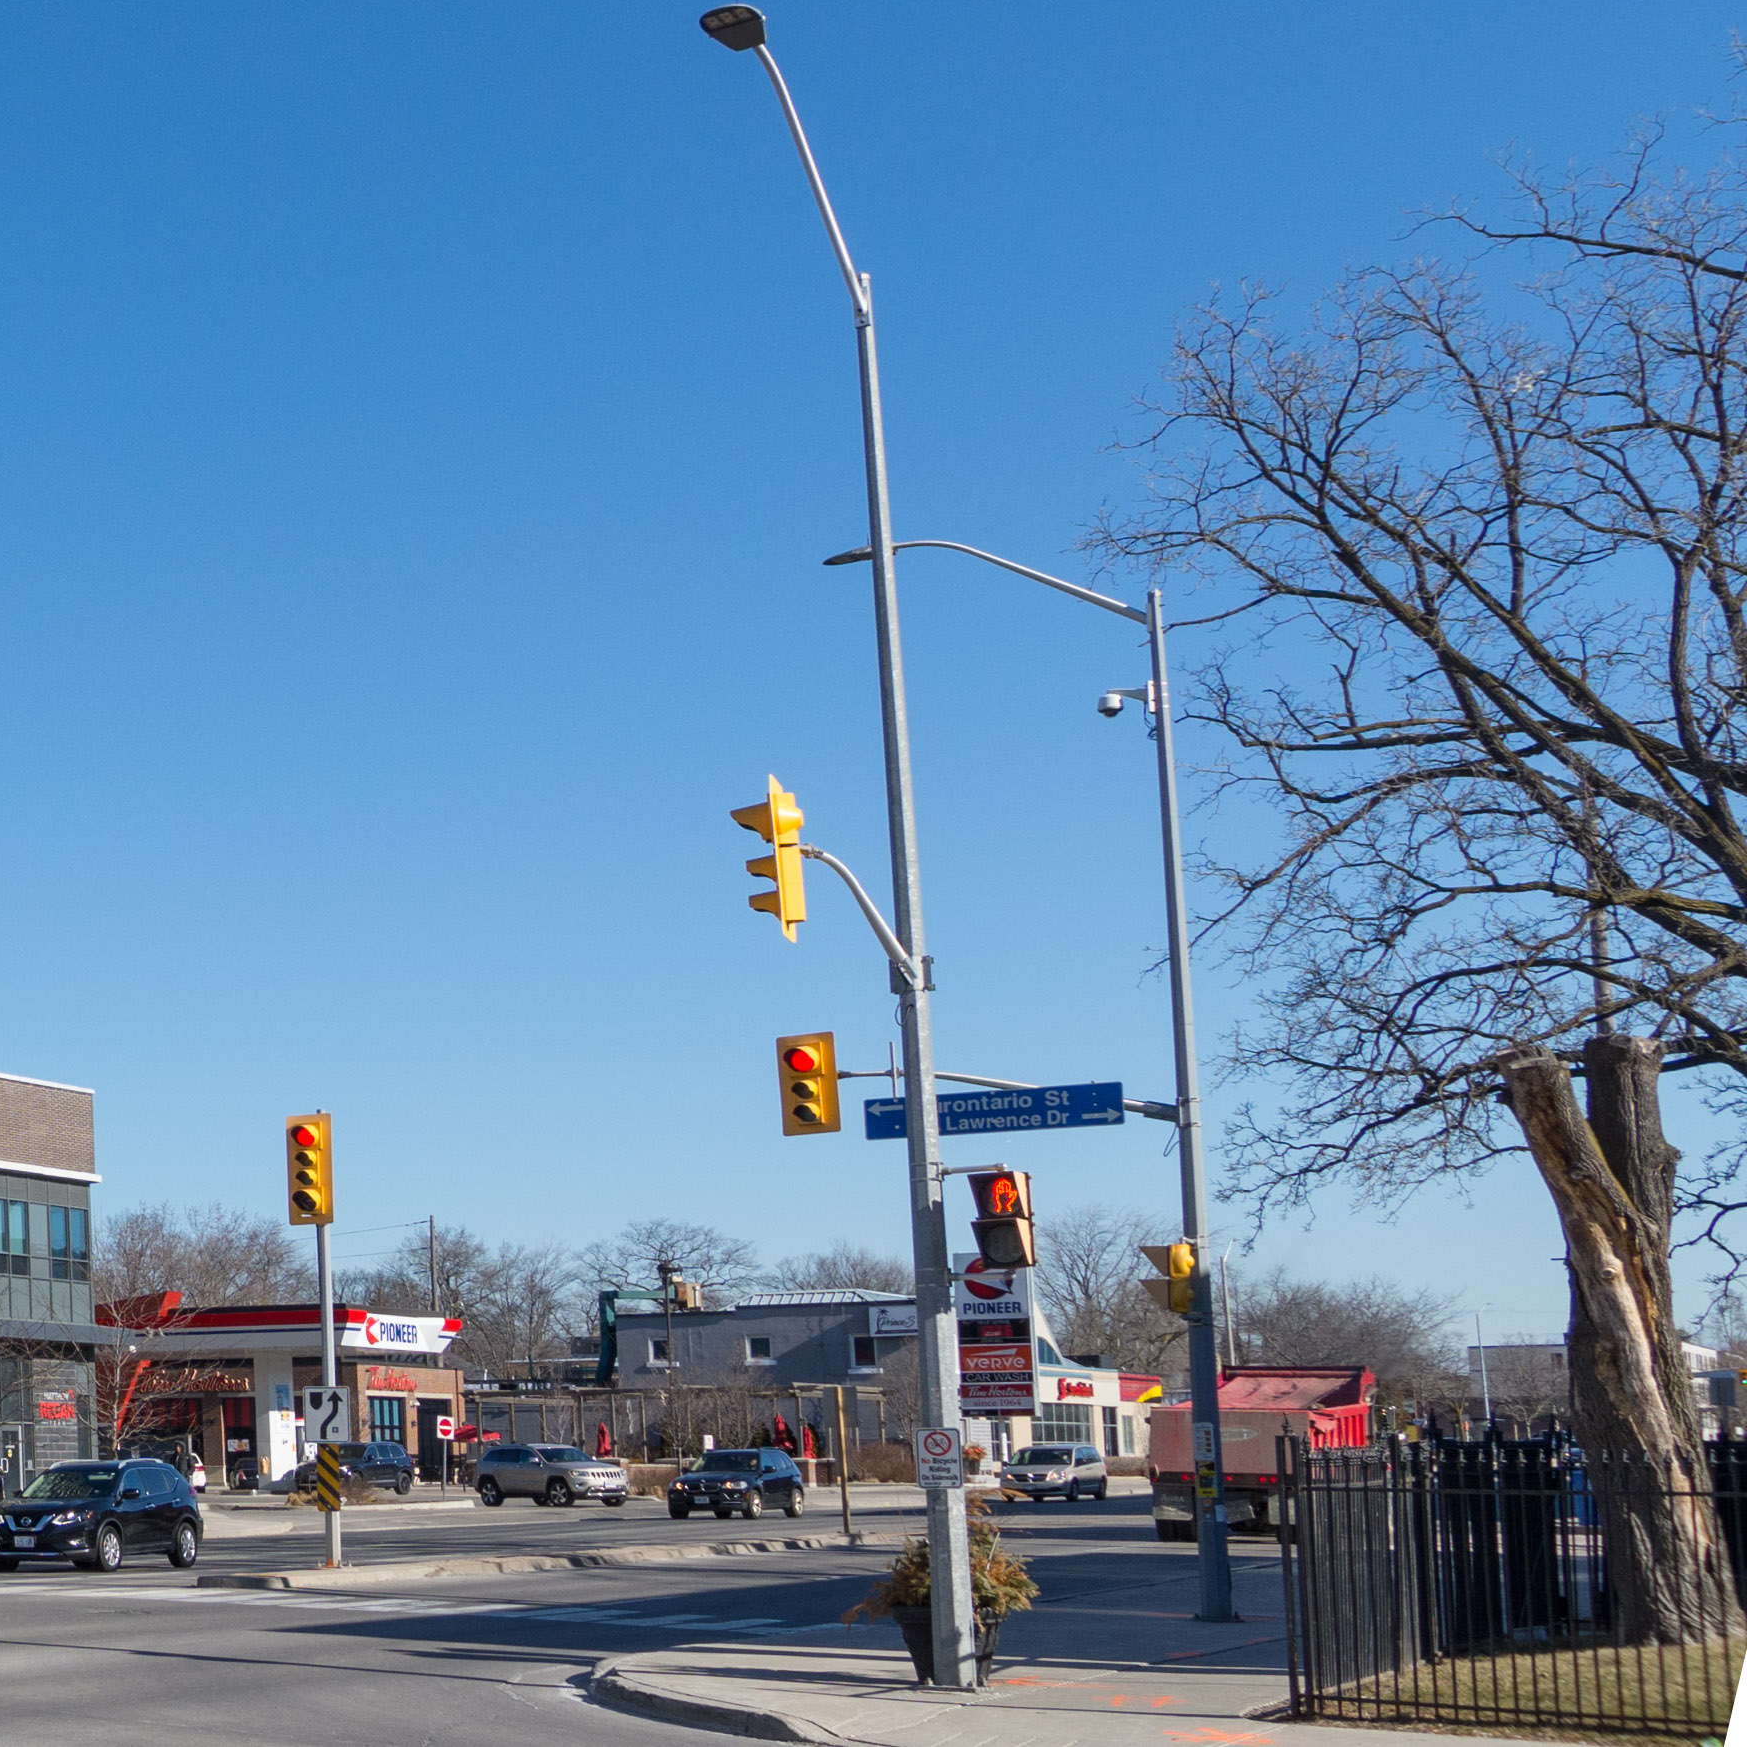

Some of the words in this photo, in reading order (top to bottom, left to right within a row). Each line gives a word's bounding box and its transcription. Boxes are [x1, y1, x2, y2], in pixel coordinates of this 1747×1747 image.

[937, 1092, 1033, 1114] rontario
[1044, 1090, 1070, 1107] St
[945, 1112, 1042, 1131] Lawrence
[1047, 1110, 1070, 1125] Dr
[963, 1301, 1023, 1315] PIONEER
[380, 1322, 418, 1345] PIONEER
[178, 1368, 250, 1392] Hortons
[965, 1374, 992, 1382] CAR
[994, 1372, 1029, 1381] WASH
[967, 1386, 987, 1397] Tim
[987, 1384, 1028, 1397] Hortons
[973, 1399, 997, 1407] since
[999, 1398, 1022, 1407] 1964
